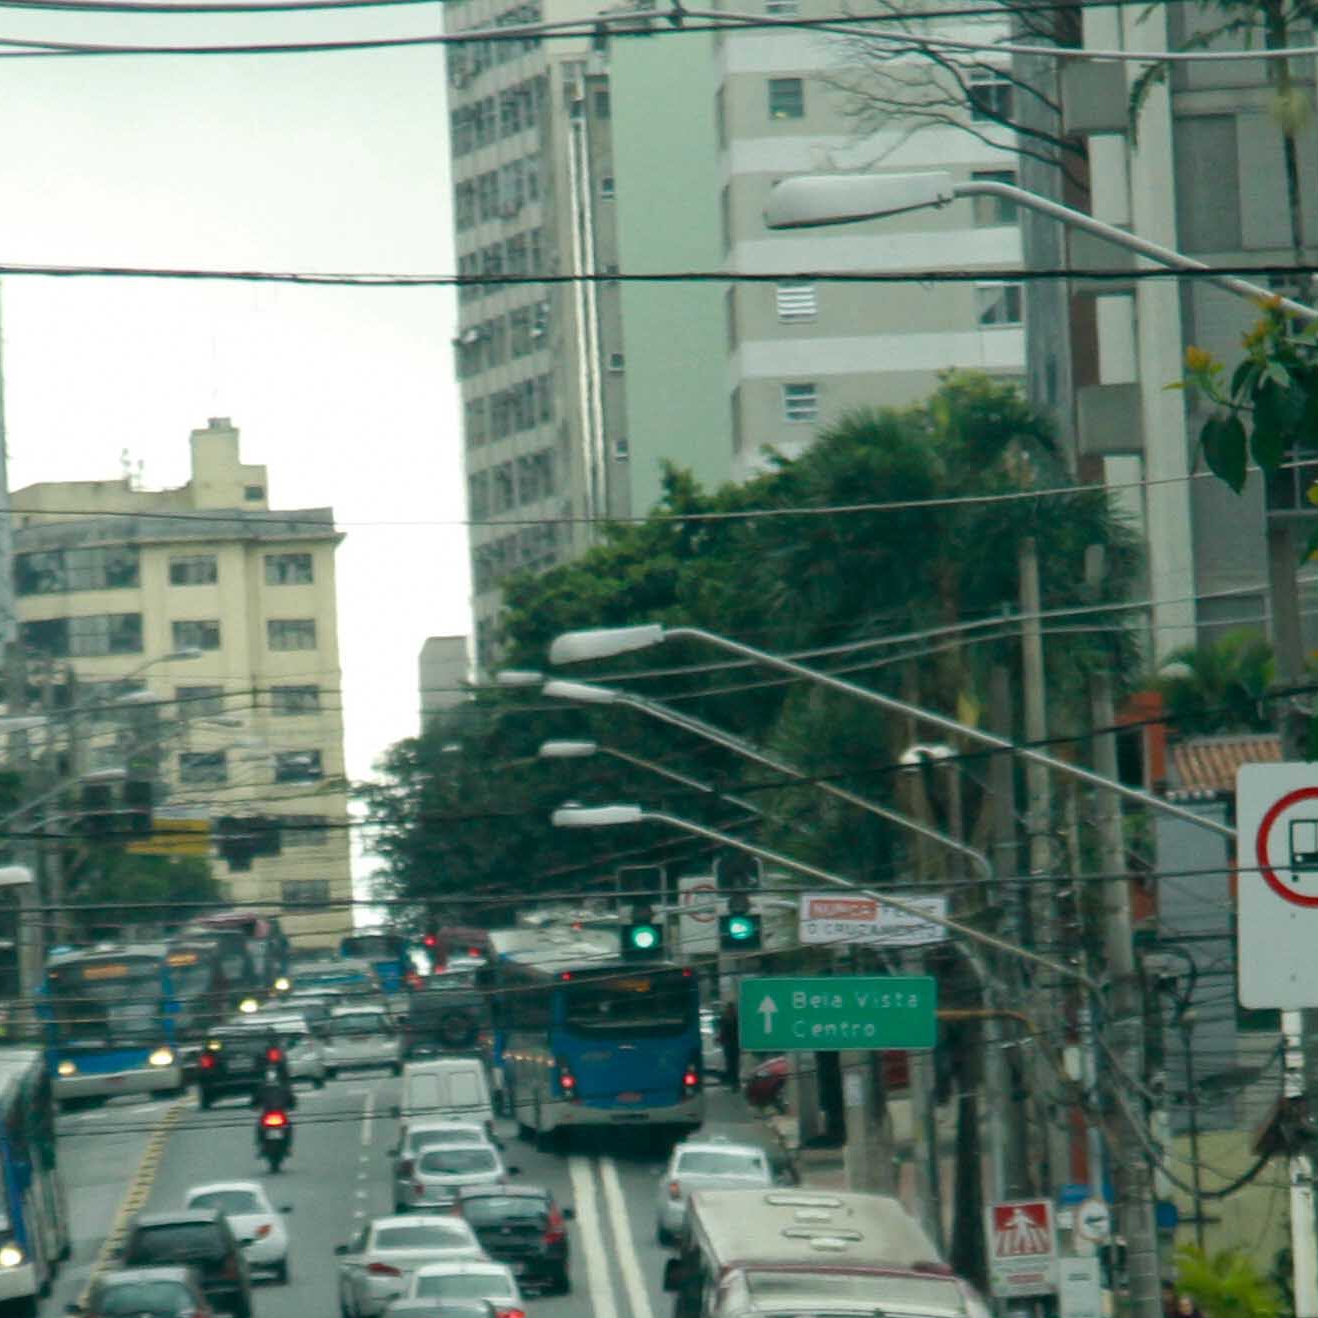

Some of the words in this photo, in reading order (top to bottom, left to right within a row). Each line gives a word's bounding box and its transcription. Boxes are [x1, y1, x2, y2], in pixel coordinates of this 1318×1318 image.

[793, 990, 843, 1009] Bela
[856, 991, 918, 1009] Vista
[794, 1019, 875, 1038] Centro
